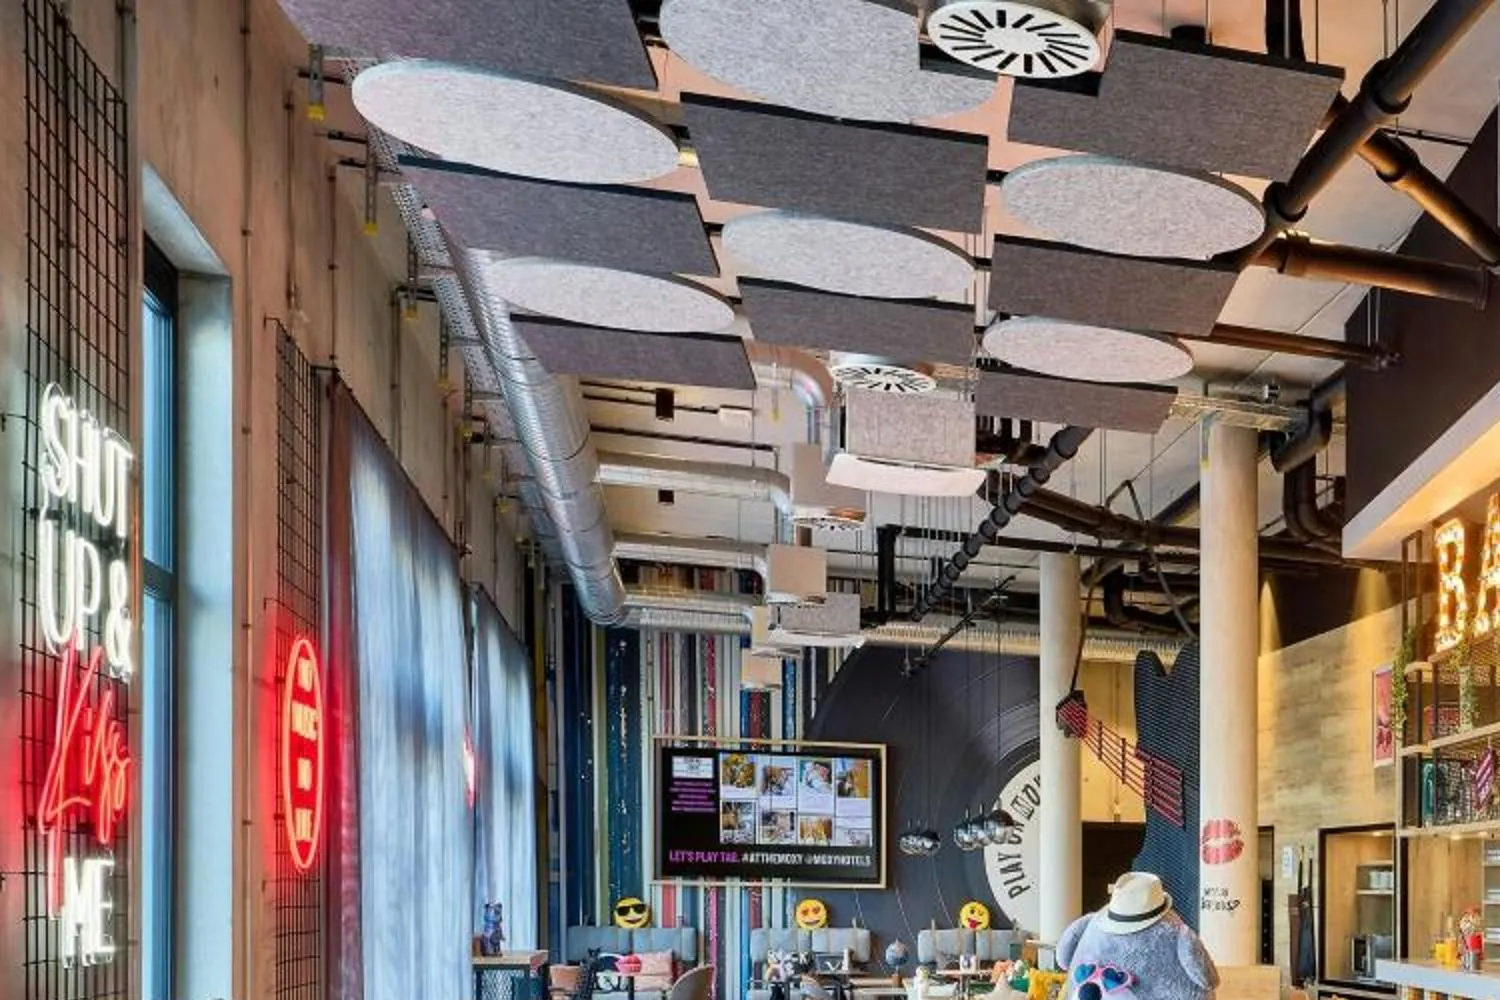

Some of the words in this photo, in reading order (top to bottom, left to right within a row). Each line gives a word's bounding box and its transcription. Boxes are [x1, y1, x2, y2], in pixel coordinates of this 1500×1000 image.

[41, 388, 133, 537] SHUT
[38, 517, 100, 651] UP
[38, 640, 131, 919] Kiss
[62, 857, 115, 965] ME
[998, 852, 1030, 899] PLAY
